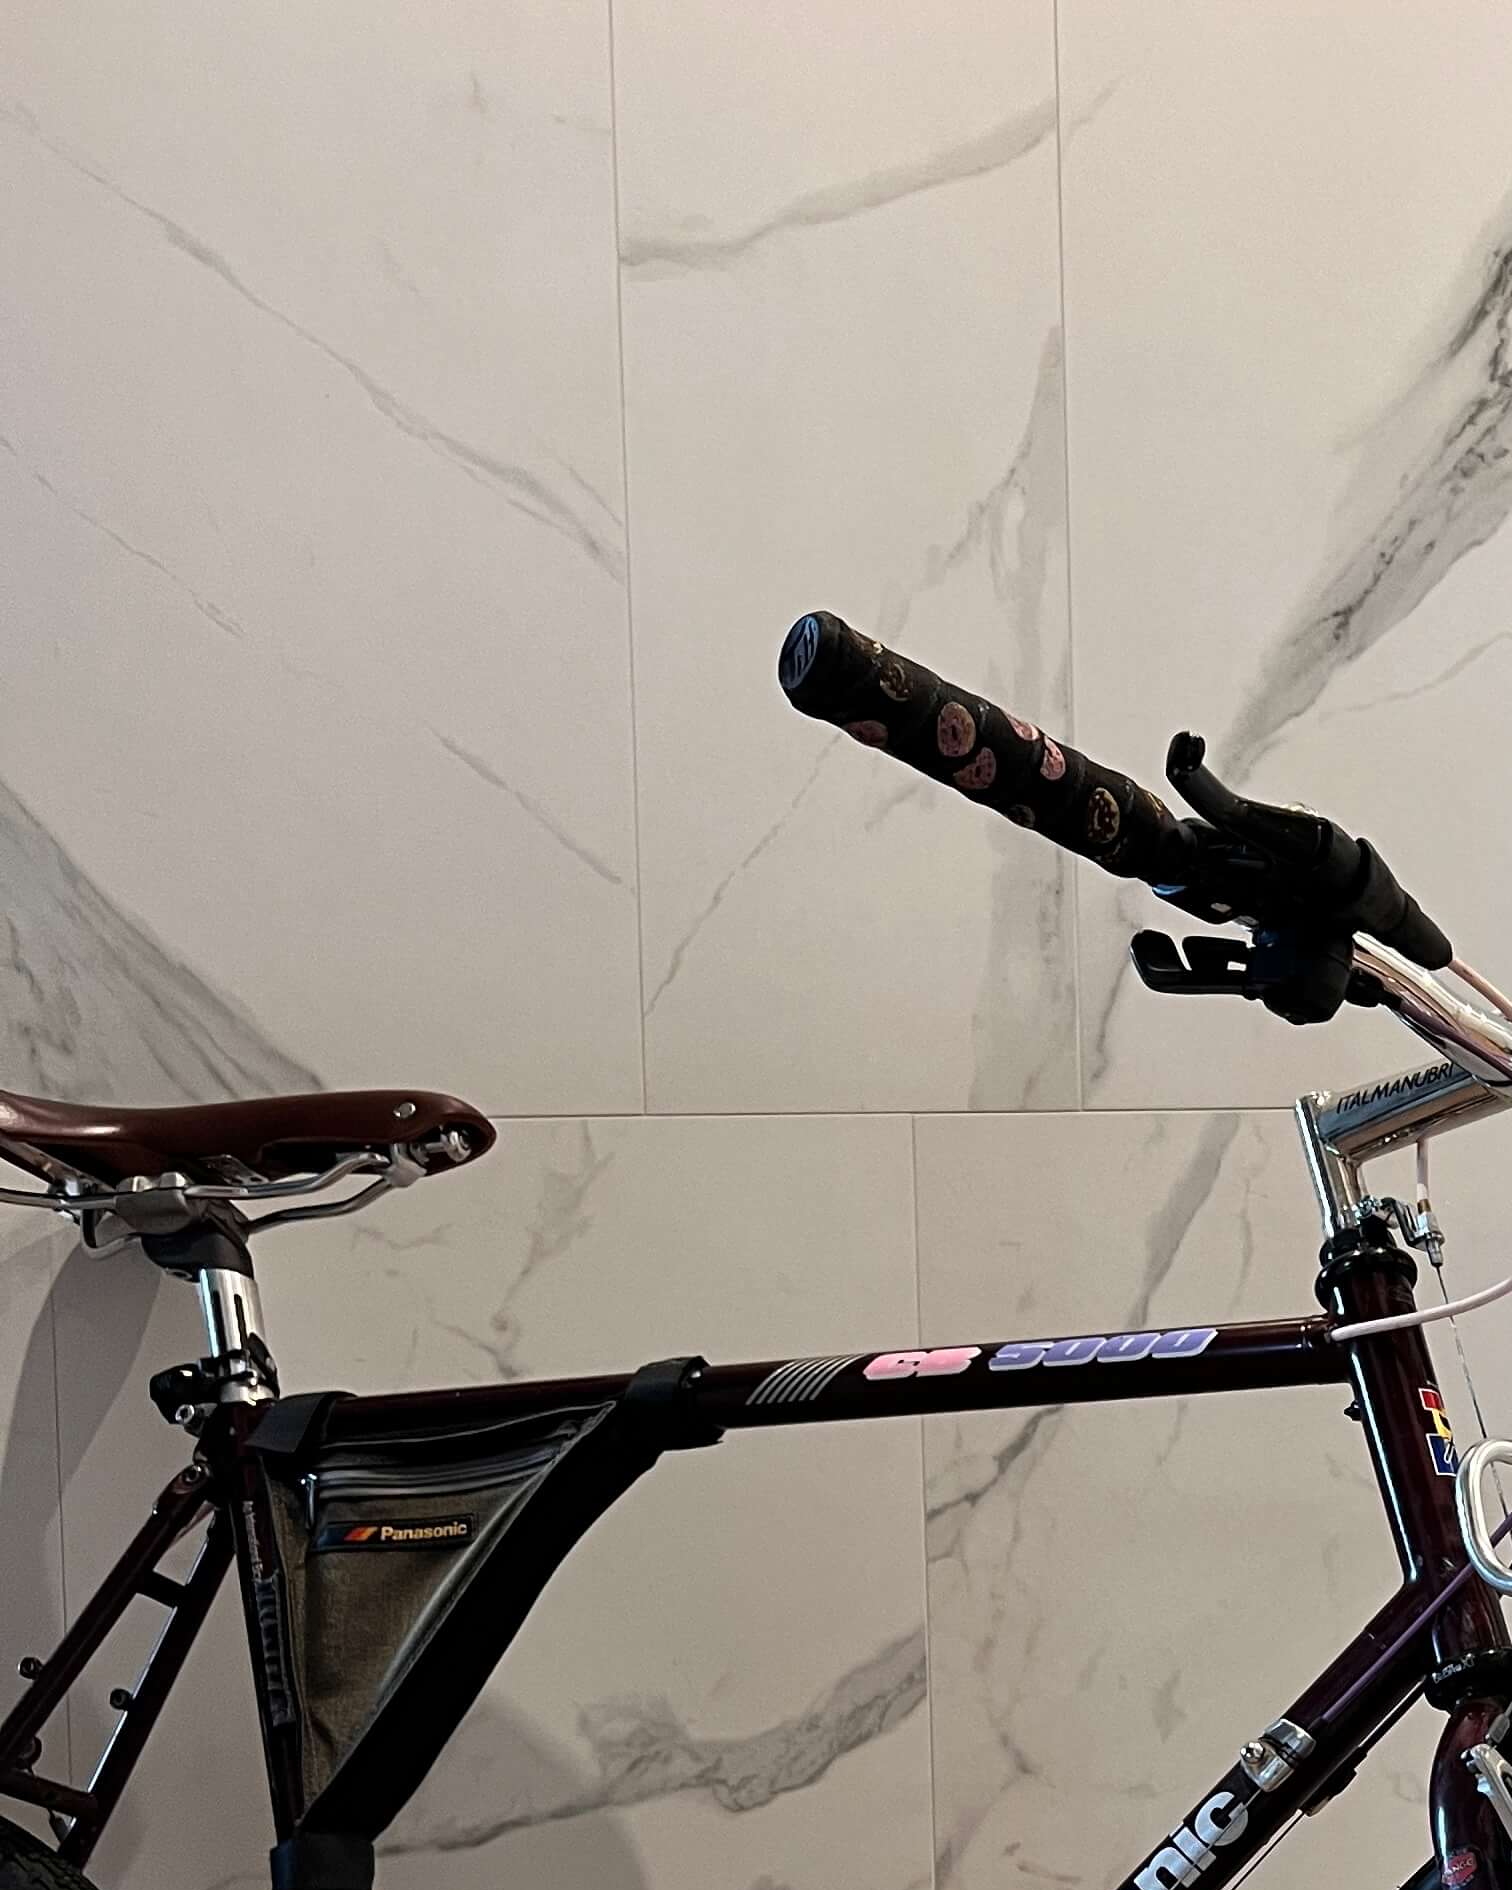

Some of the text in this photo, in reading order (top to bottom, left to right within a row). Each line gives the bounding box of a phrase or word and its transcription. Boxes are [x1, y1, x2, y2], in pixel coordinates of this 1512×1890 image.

[1336, 1063, 1455, 1114] ITALMANUBRI
[988, 1328, 1219, 1372] 5000
[380, 1520, 468, 1542] Panasonic
